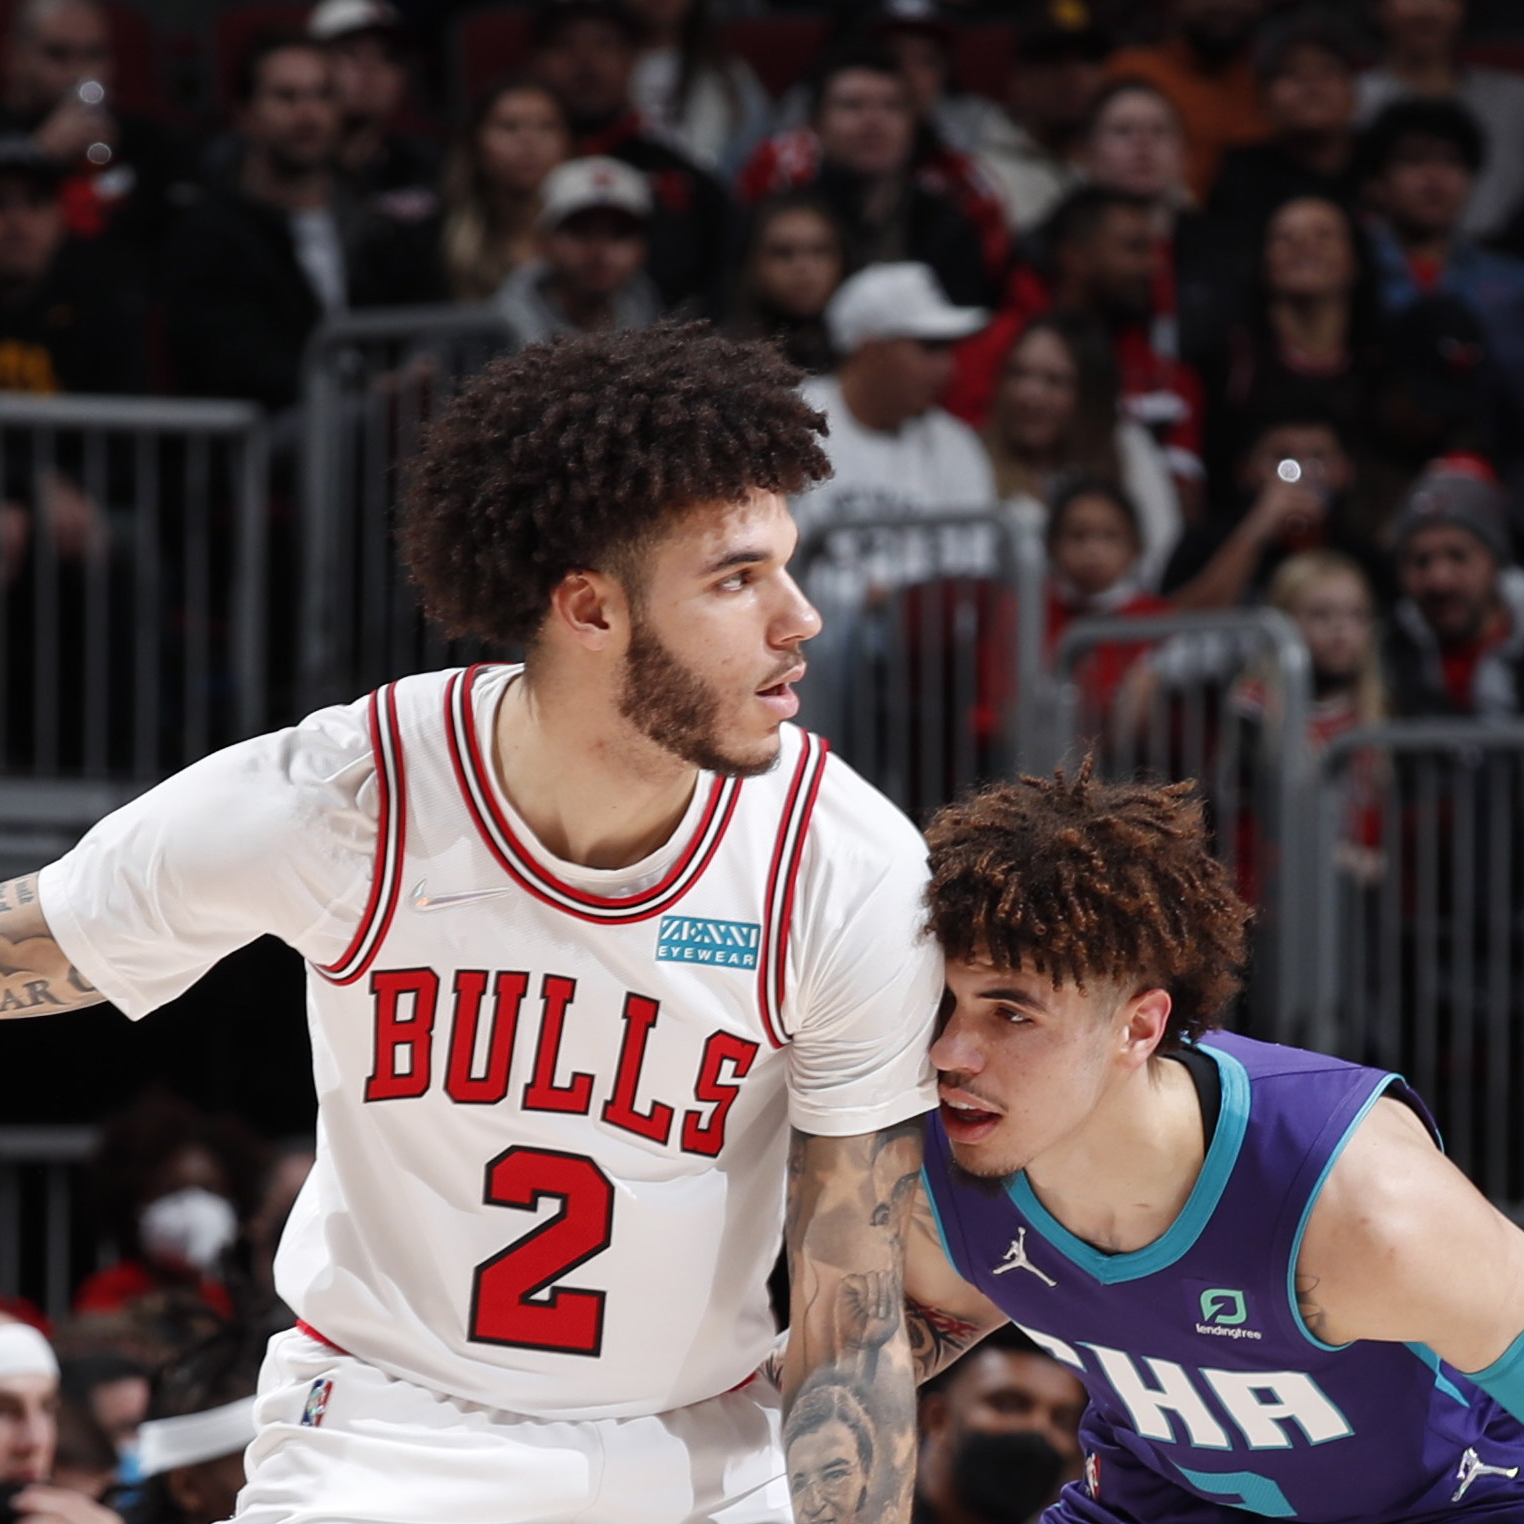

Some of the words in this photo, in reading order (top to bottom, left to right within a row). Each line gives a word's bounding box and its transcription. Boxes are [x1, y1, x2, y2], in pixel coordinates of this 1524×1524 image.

[660, 919, 759, 949] ZENNI
[658, 945, 755, 966] EYEWEAR
[363, 966, 760, 1159] BULLS
[467, 1144, 615, 1359] 2
[1195, 1322, 1263, 1340] lendingtree
